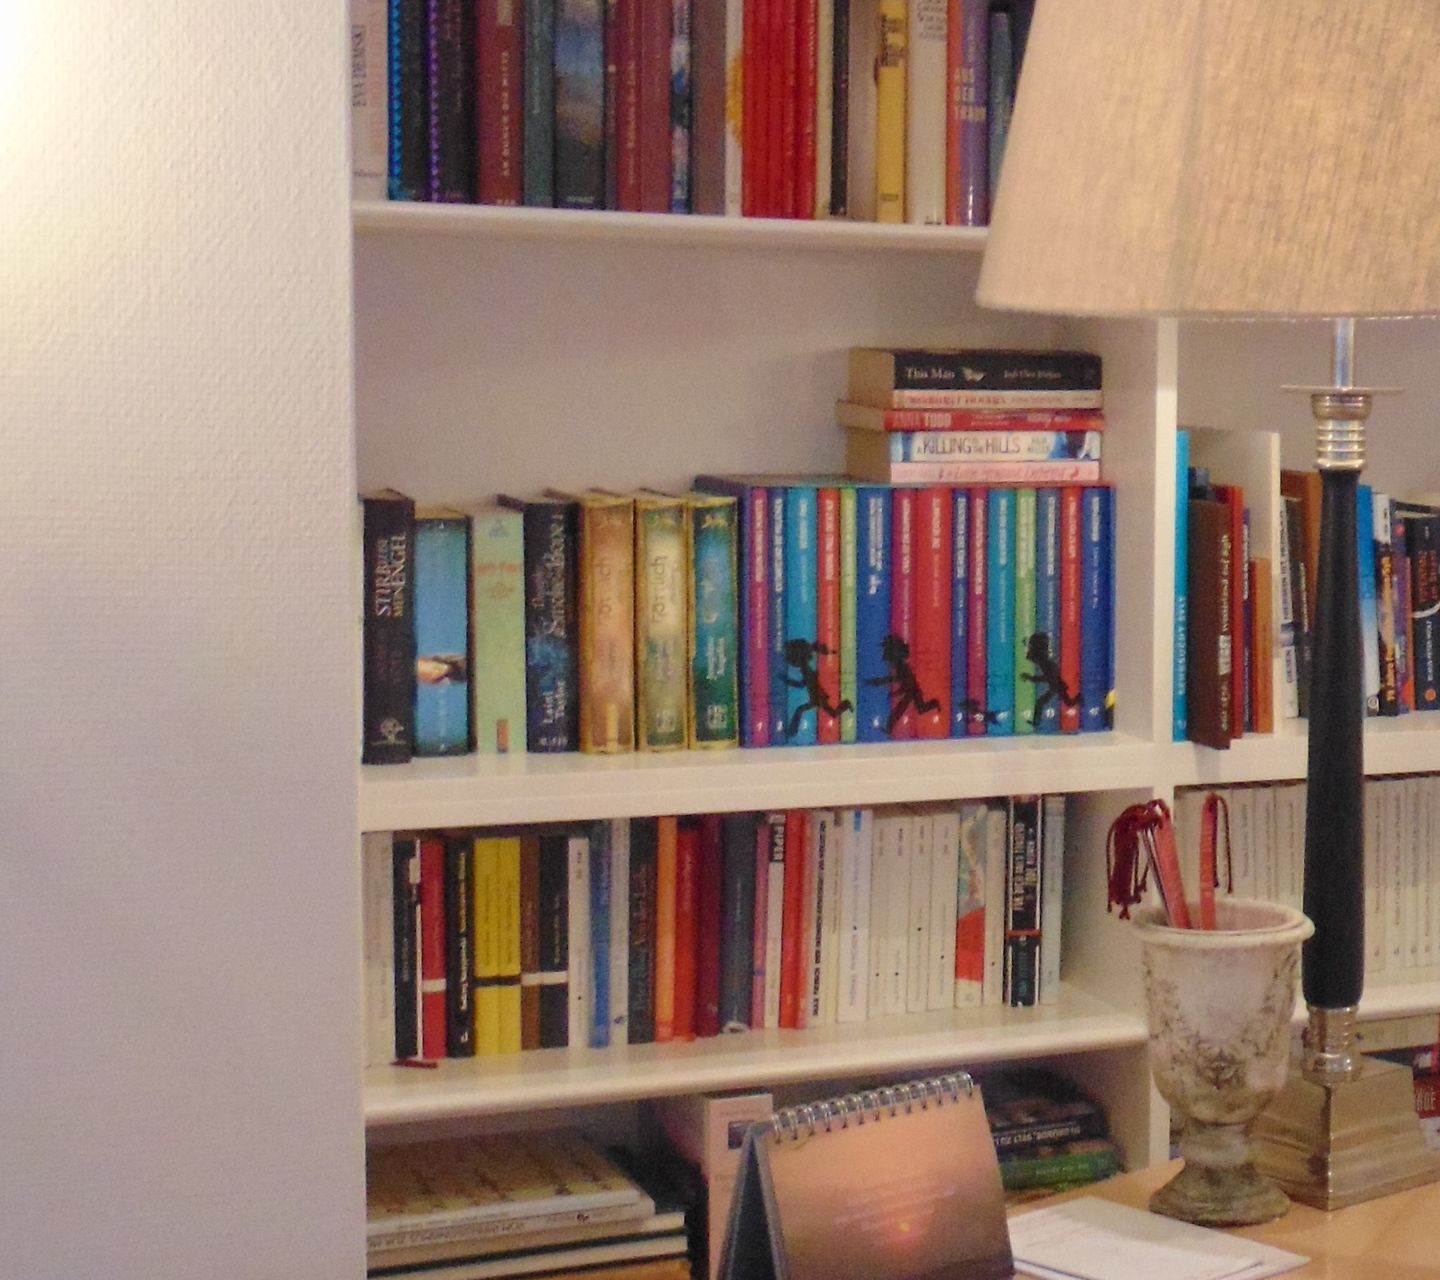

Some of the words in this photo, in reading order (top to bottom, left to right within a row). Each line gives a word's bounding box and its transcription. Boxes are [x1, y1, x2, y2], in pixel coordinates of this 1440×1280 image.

[931, 368, 955, 380] Man
[923, 438, 972, 455] KILLING
[984, 438, 1020, 455] HILLS
[391, 535, 406, 587] ENGEL
[772, 825, 784, 861] PIPER
